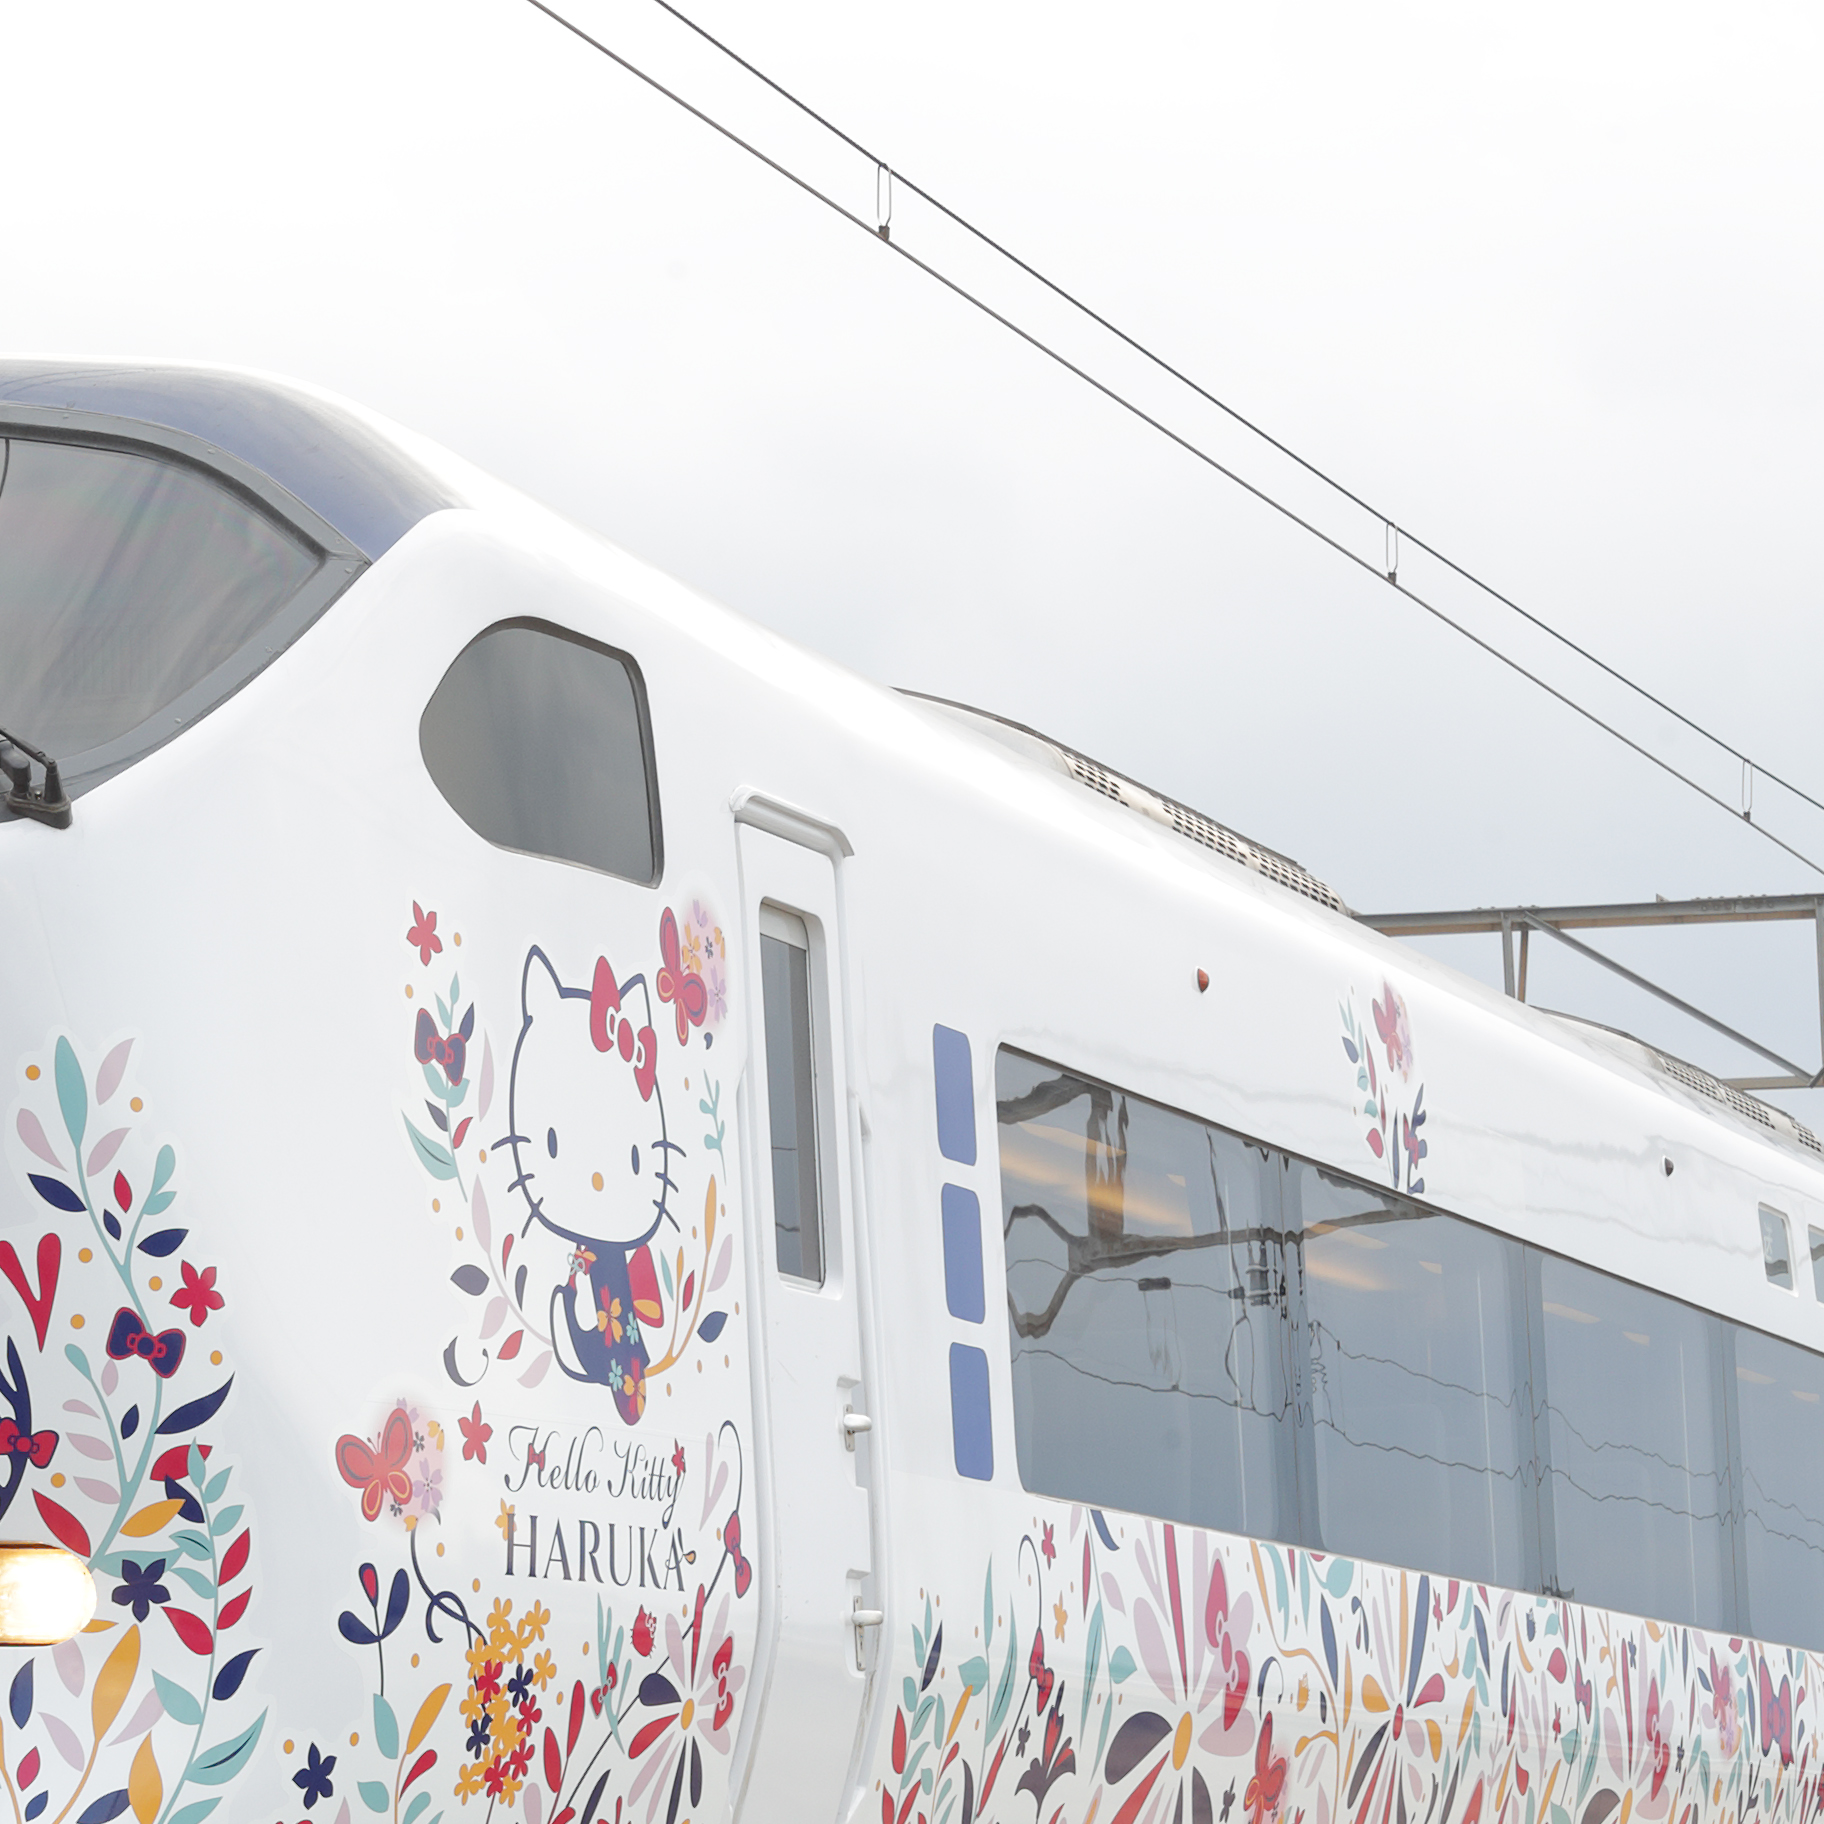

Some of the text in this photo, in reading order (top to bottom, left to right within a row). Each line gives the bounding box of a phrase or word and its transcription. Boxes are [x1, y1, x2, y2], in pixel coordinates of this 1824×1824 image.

[504, 1425, 686, 1530] Hello Kitty
[504, 1513, 686, 1593] HARUKA
